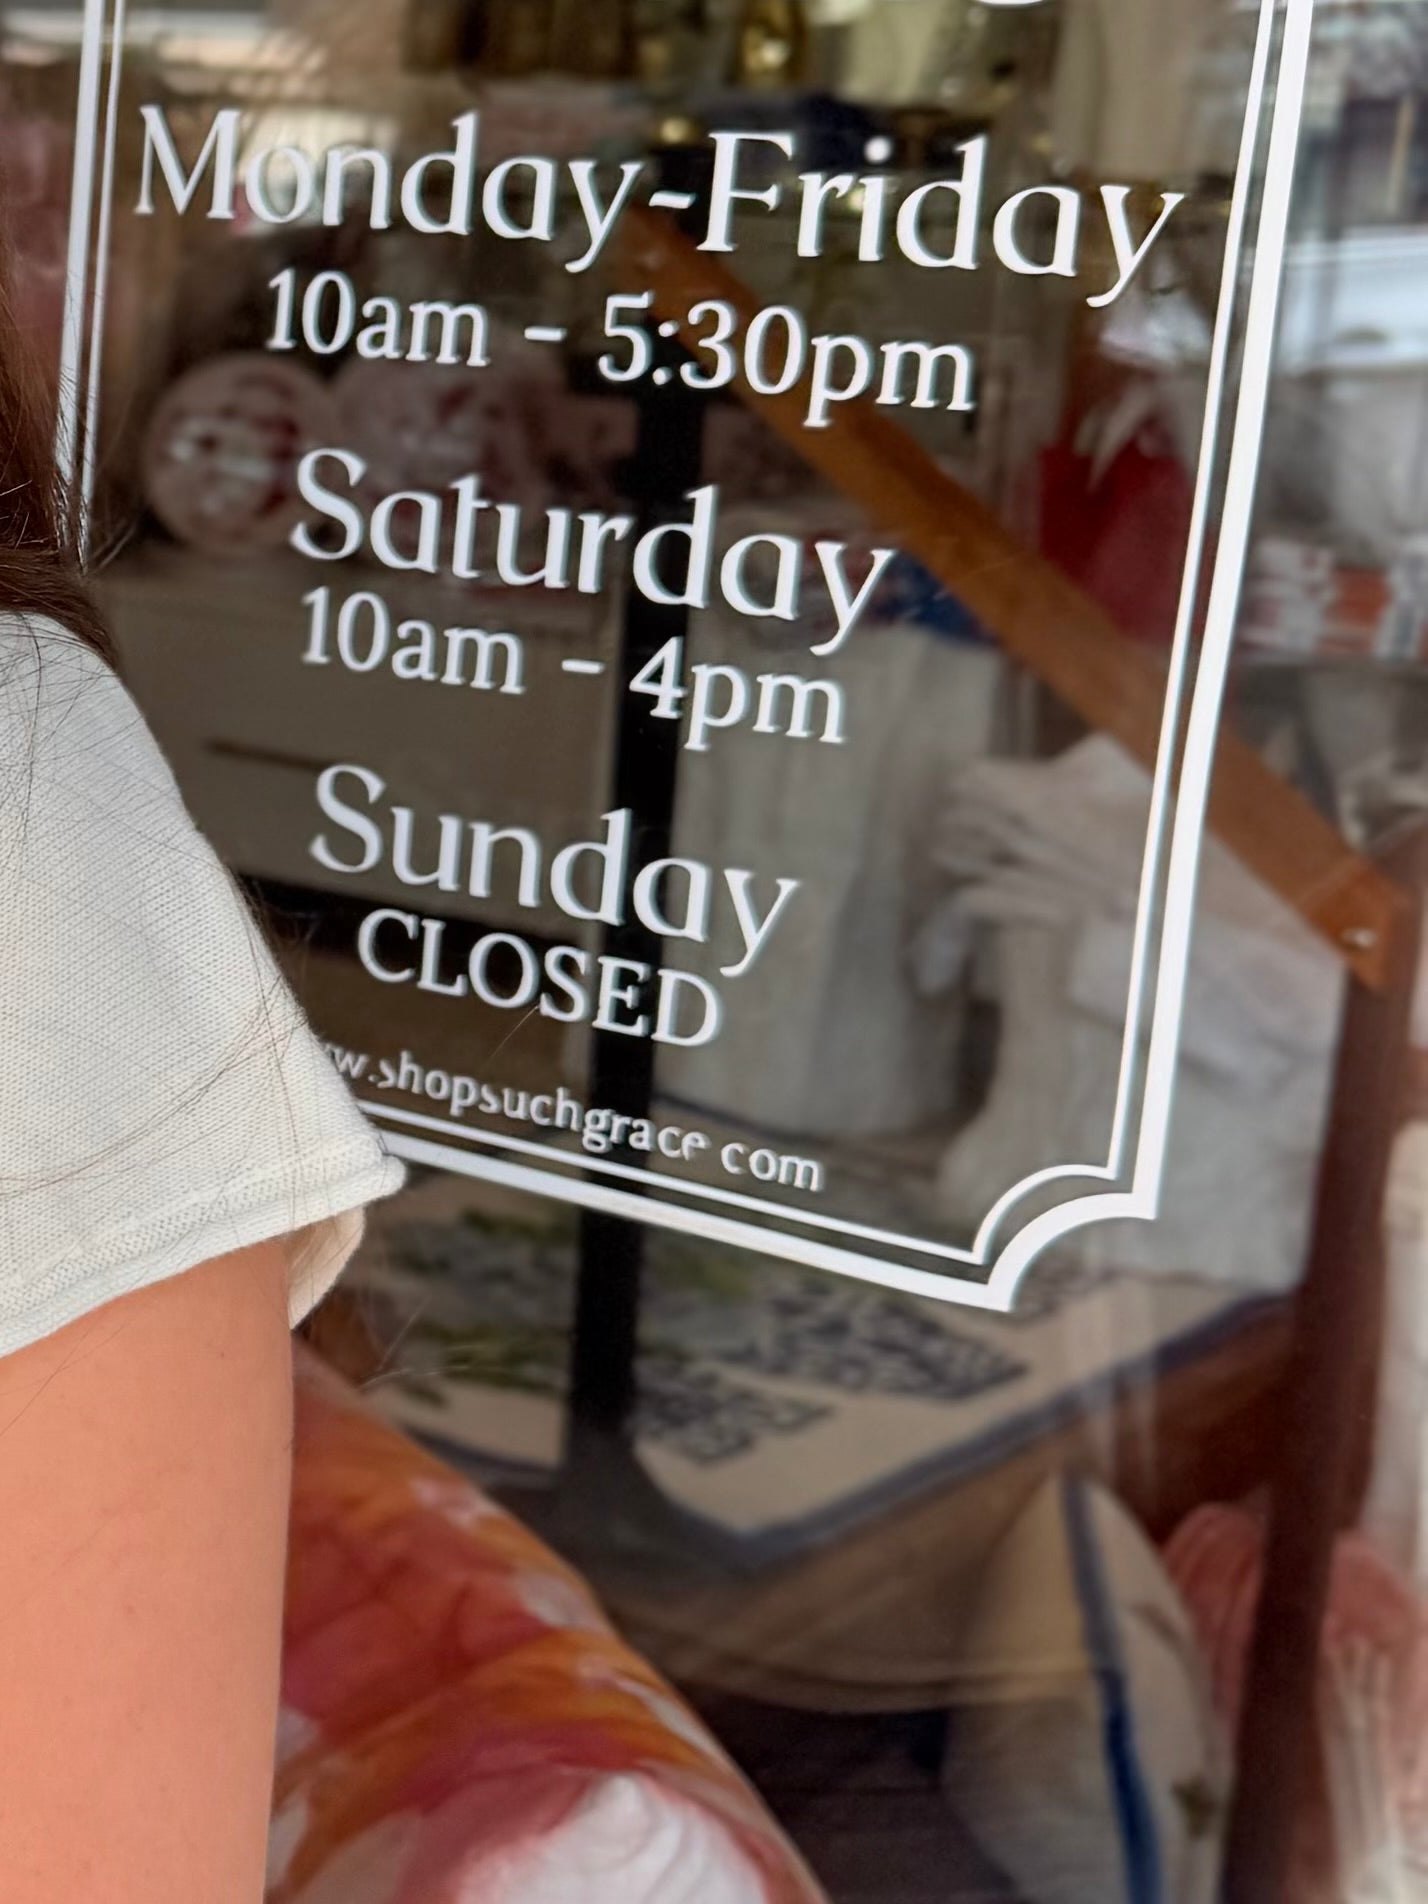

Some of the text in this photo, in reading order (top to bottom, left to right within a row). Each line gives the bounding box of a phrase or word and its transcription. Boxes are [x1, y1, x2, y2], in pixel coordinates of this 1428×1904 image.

[133, 104, 1186, 308] Monday-Friday
[266, 268, 490, 367] 10am
[597, 290, 976, 429] 5:30pm
[290, 447, 899, 657] Saturday
[302, 586, 525, 695] 10am
[628, 635, 847, 752] 4pm
[309, 764, 800, 978] Sunday
[357, 907, 724, 1048] CLOSED
